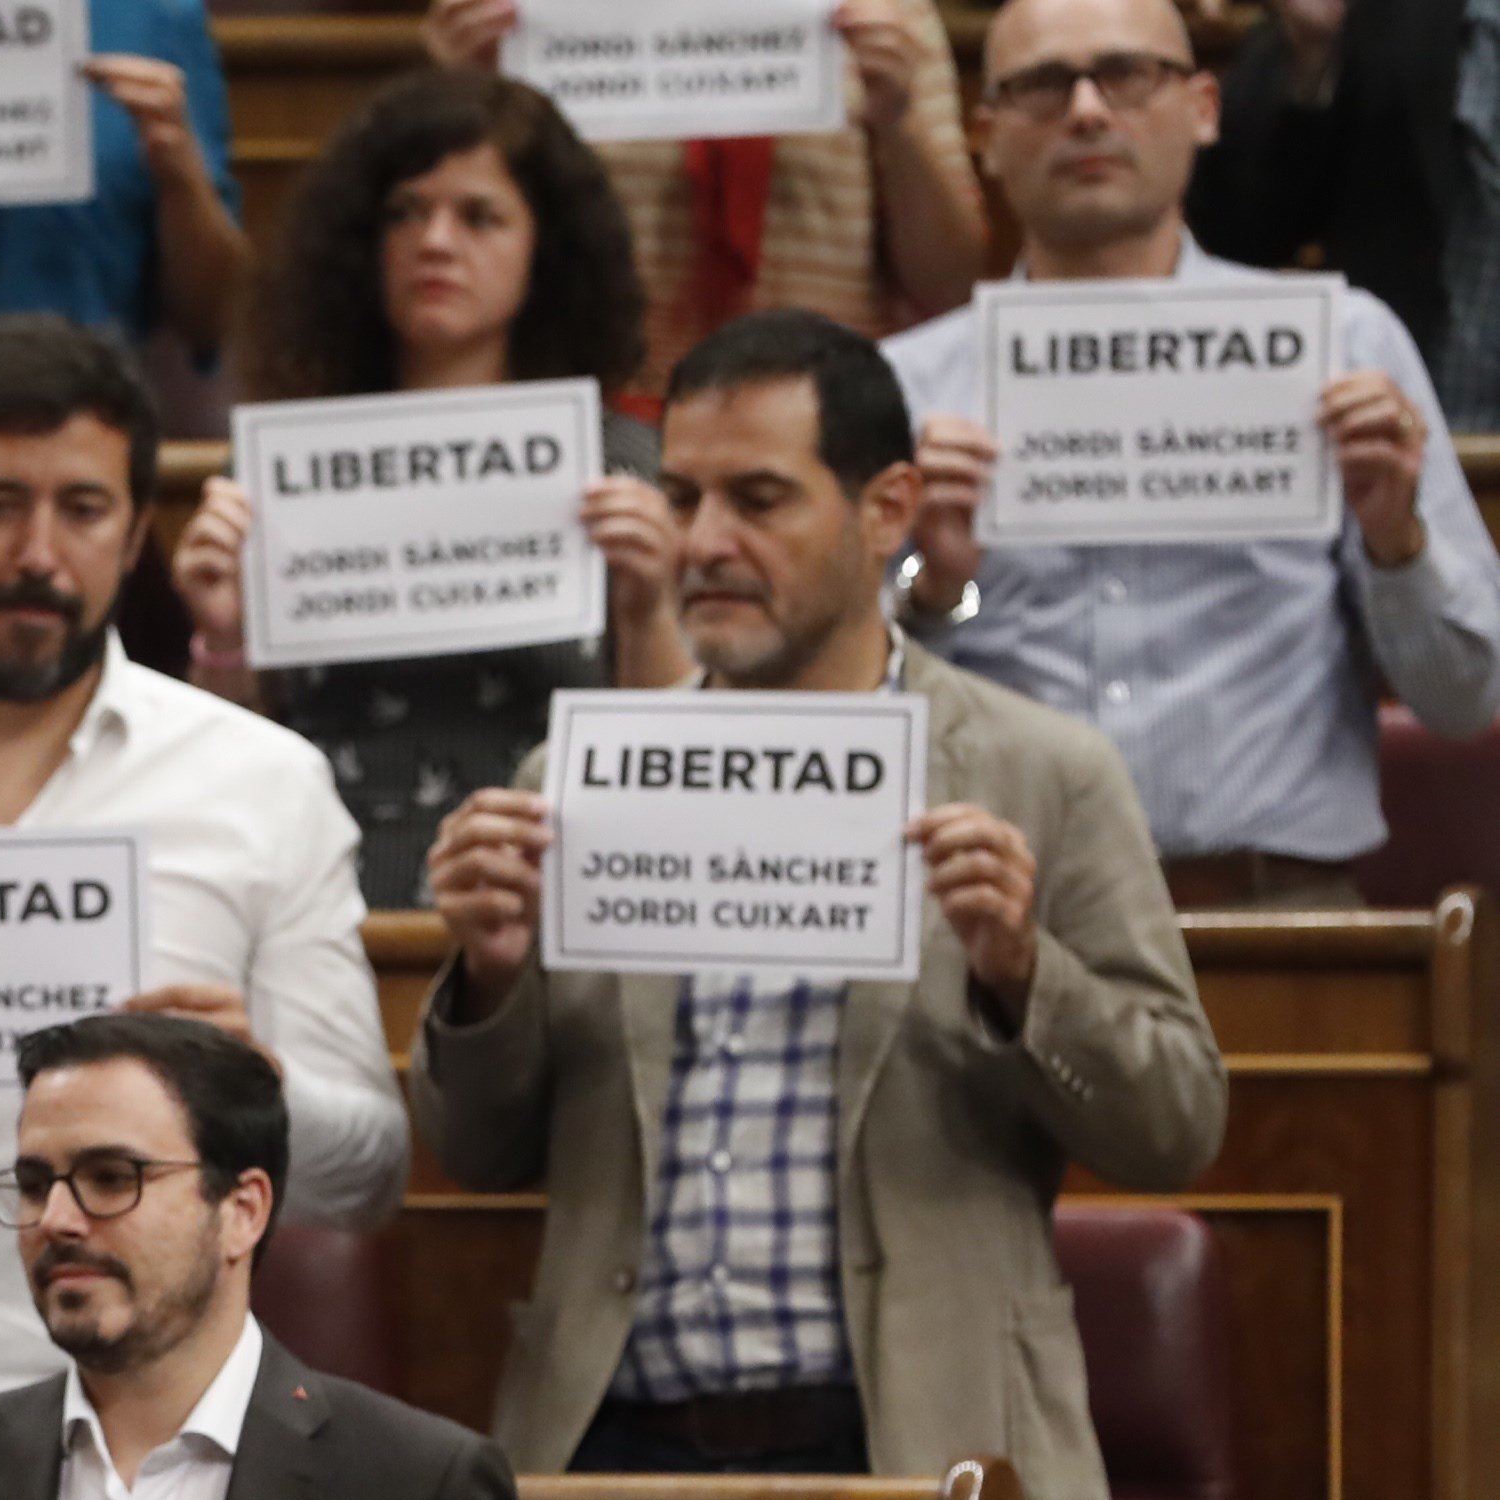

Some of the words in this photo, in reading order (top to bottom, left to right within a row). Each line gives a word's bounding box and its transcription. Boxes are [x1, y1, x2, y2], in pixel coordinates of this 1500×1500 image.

[1011, 325, 1306, 376] LIBERTAD
[1015, 432, 1122, 459] JORDI
[274, 434, 562, 495] LIBERTAD
[1021, 474, 1127, 502] JORDI
[284, 548, 388, 578] JORDI
[290, 591, 396, 621] JORDI
[582, 747, 885, 794] LIBERTAD
[580, 852, 692, 881] JORDI
[707, 848, 877, 886] SÀNCHEZ
[586, 897, 697, 926] JORDI
[711, 901, 870, 930] CUIXART
